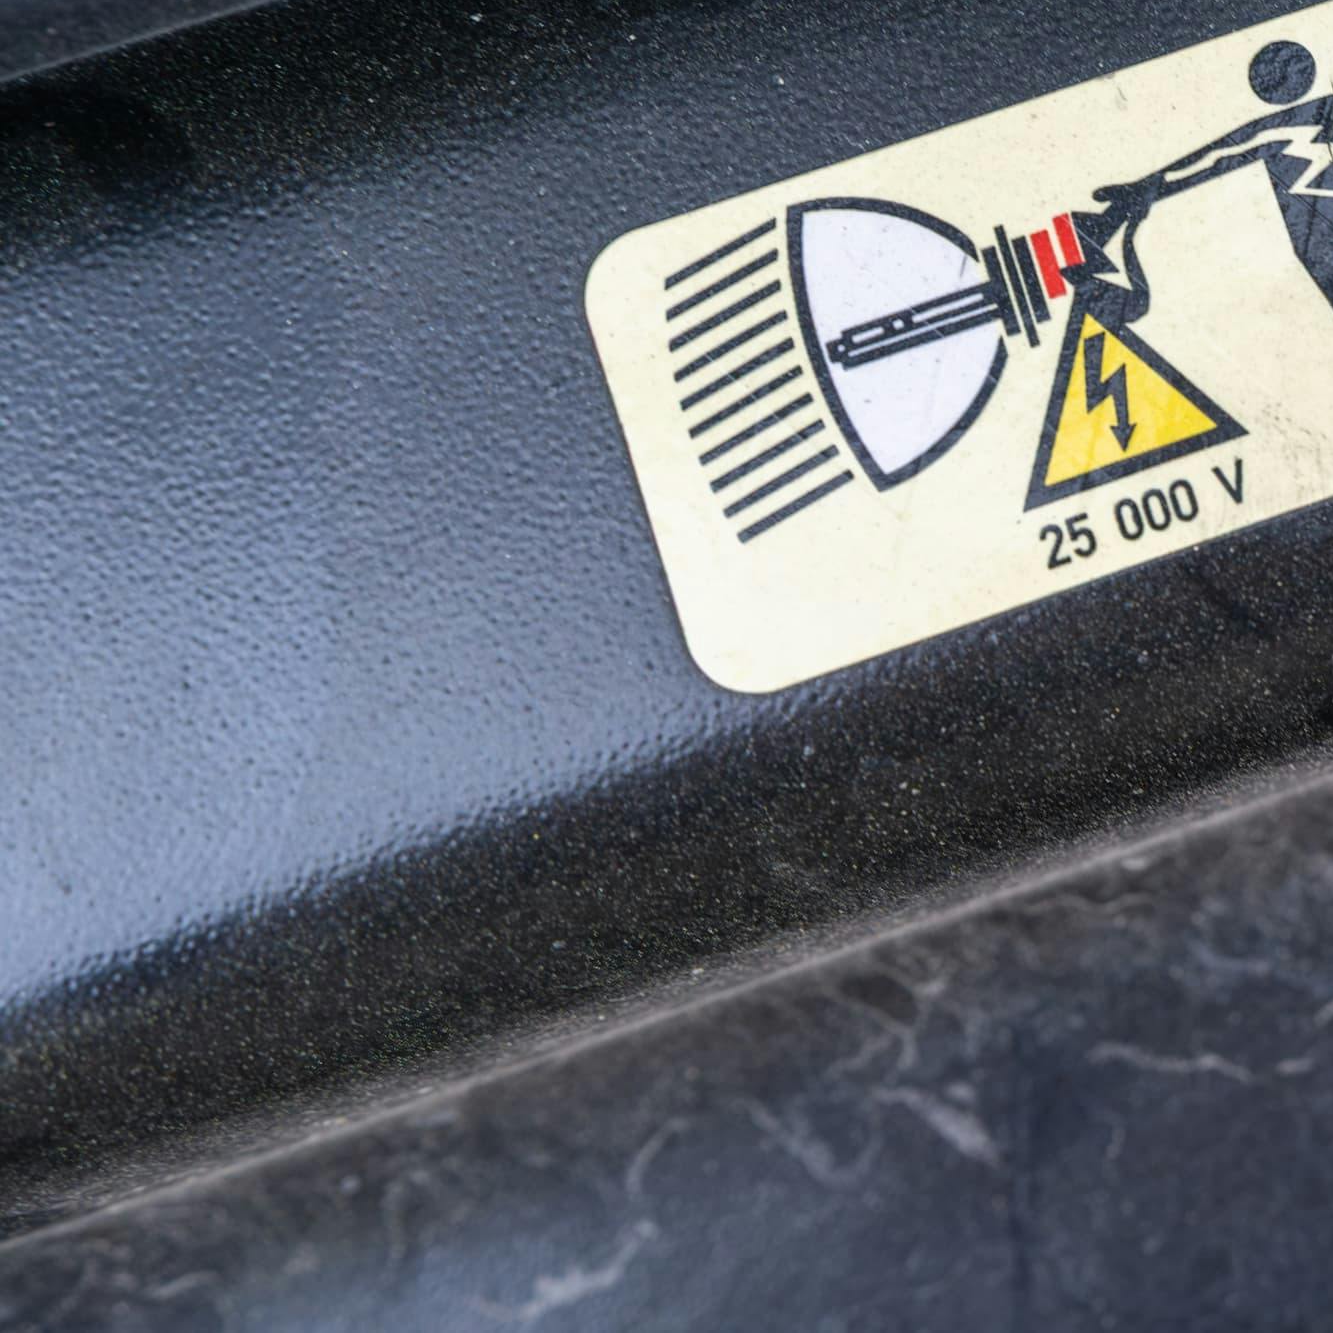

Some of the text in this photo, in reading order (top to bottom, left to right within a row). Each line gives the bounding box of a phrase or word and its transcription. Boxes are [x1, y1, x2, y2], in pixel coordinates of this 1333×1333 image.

[1040, 458, 1246, 569] 25 000 V
